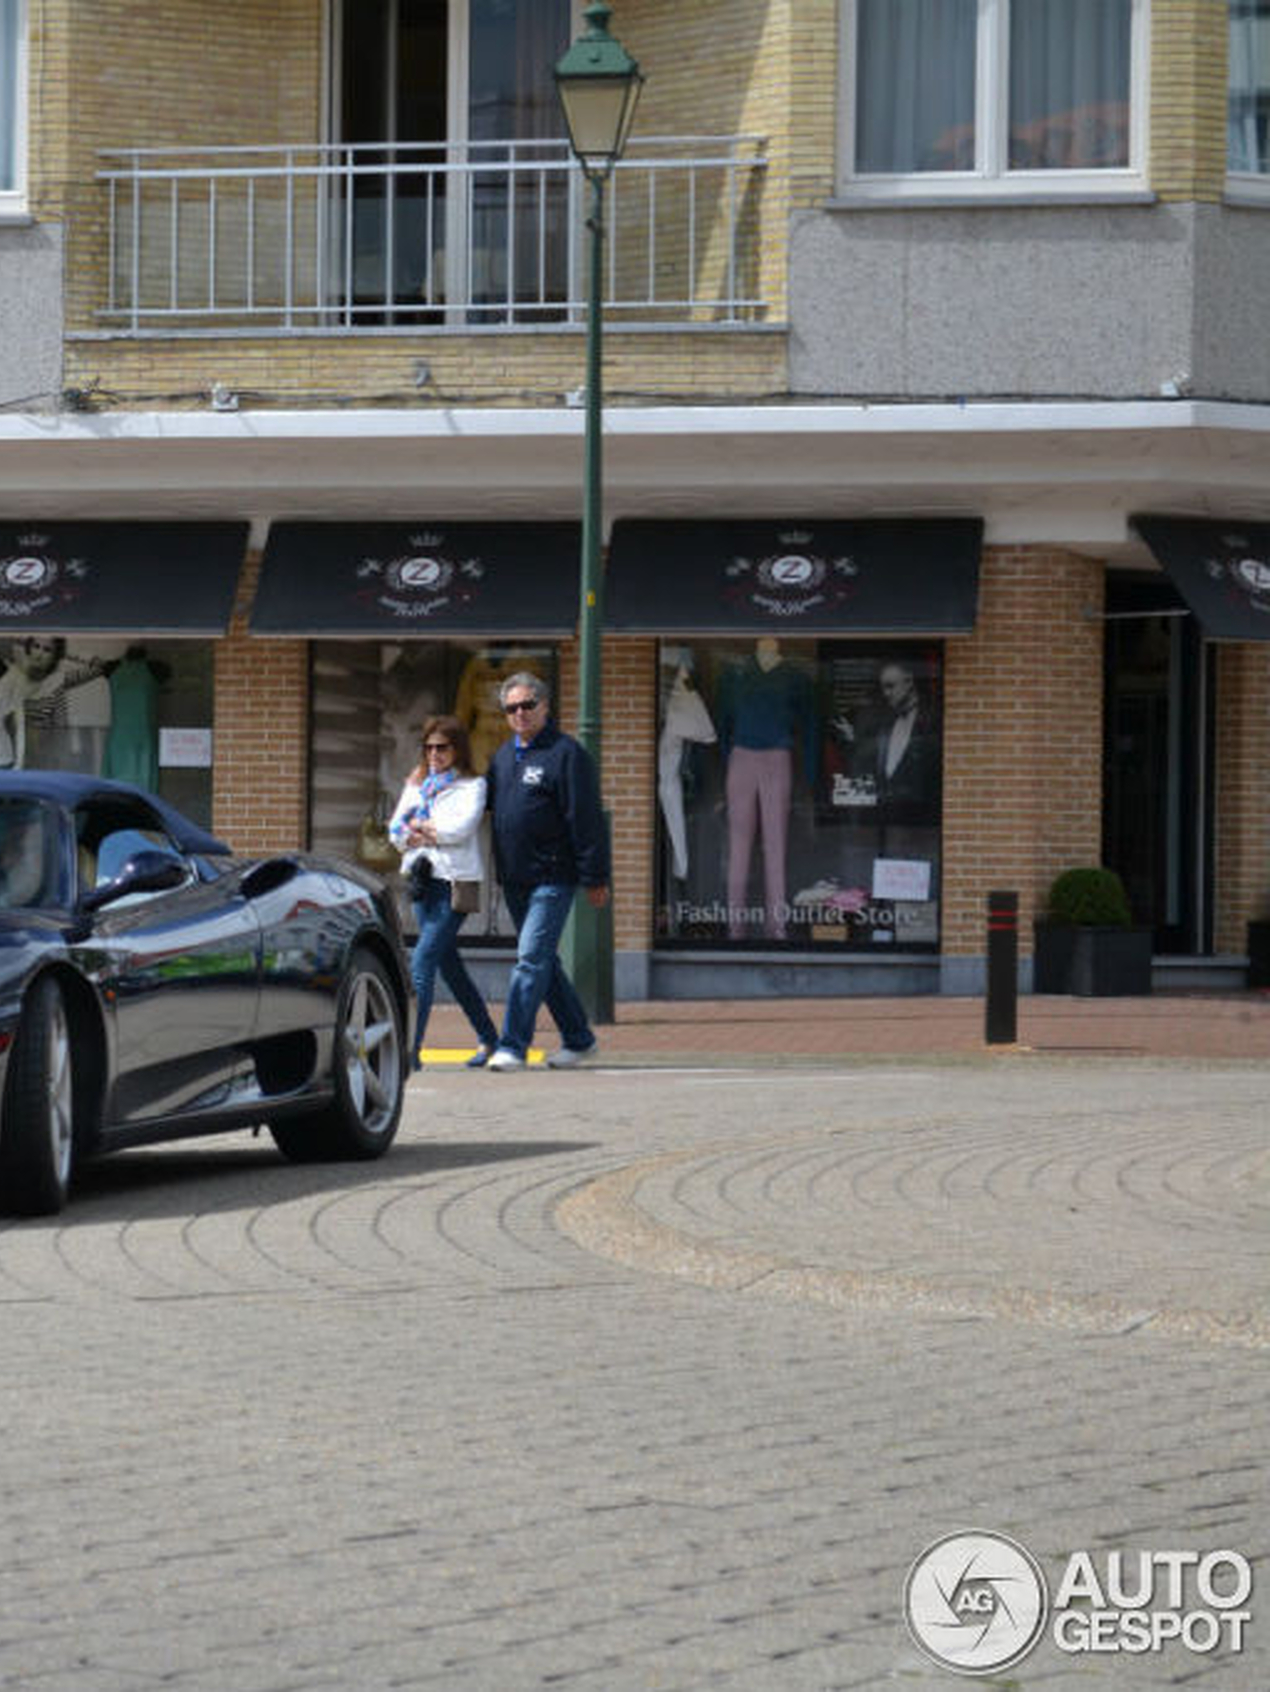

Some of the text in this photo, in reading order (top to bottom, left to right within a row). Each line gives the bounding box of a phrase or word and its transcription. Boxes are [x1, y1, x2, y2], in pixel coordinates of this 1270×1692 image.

[676, 901, 917, 925] Fashion Outlet Store
